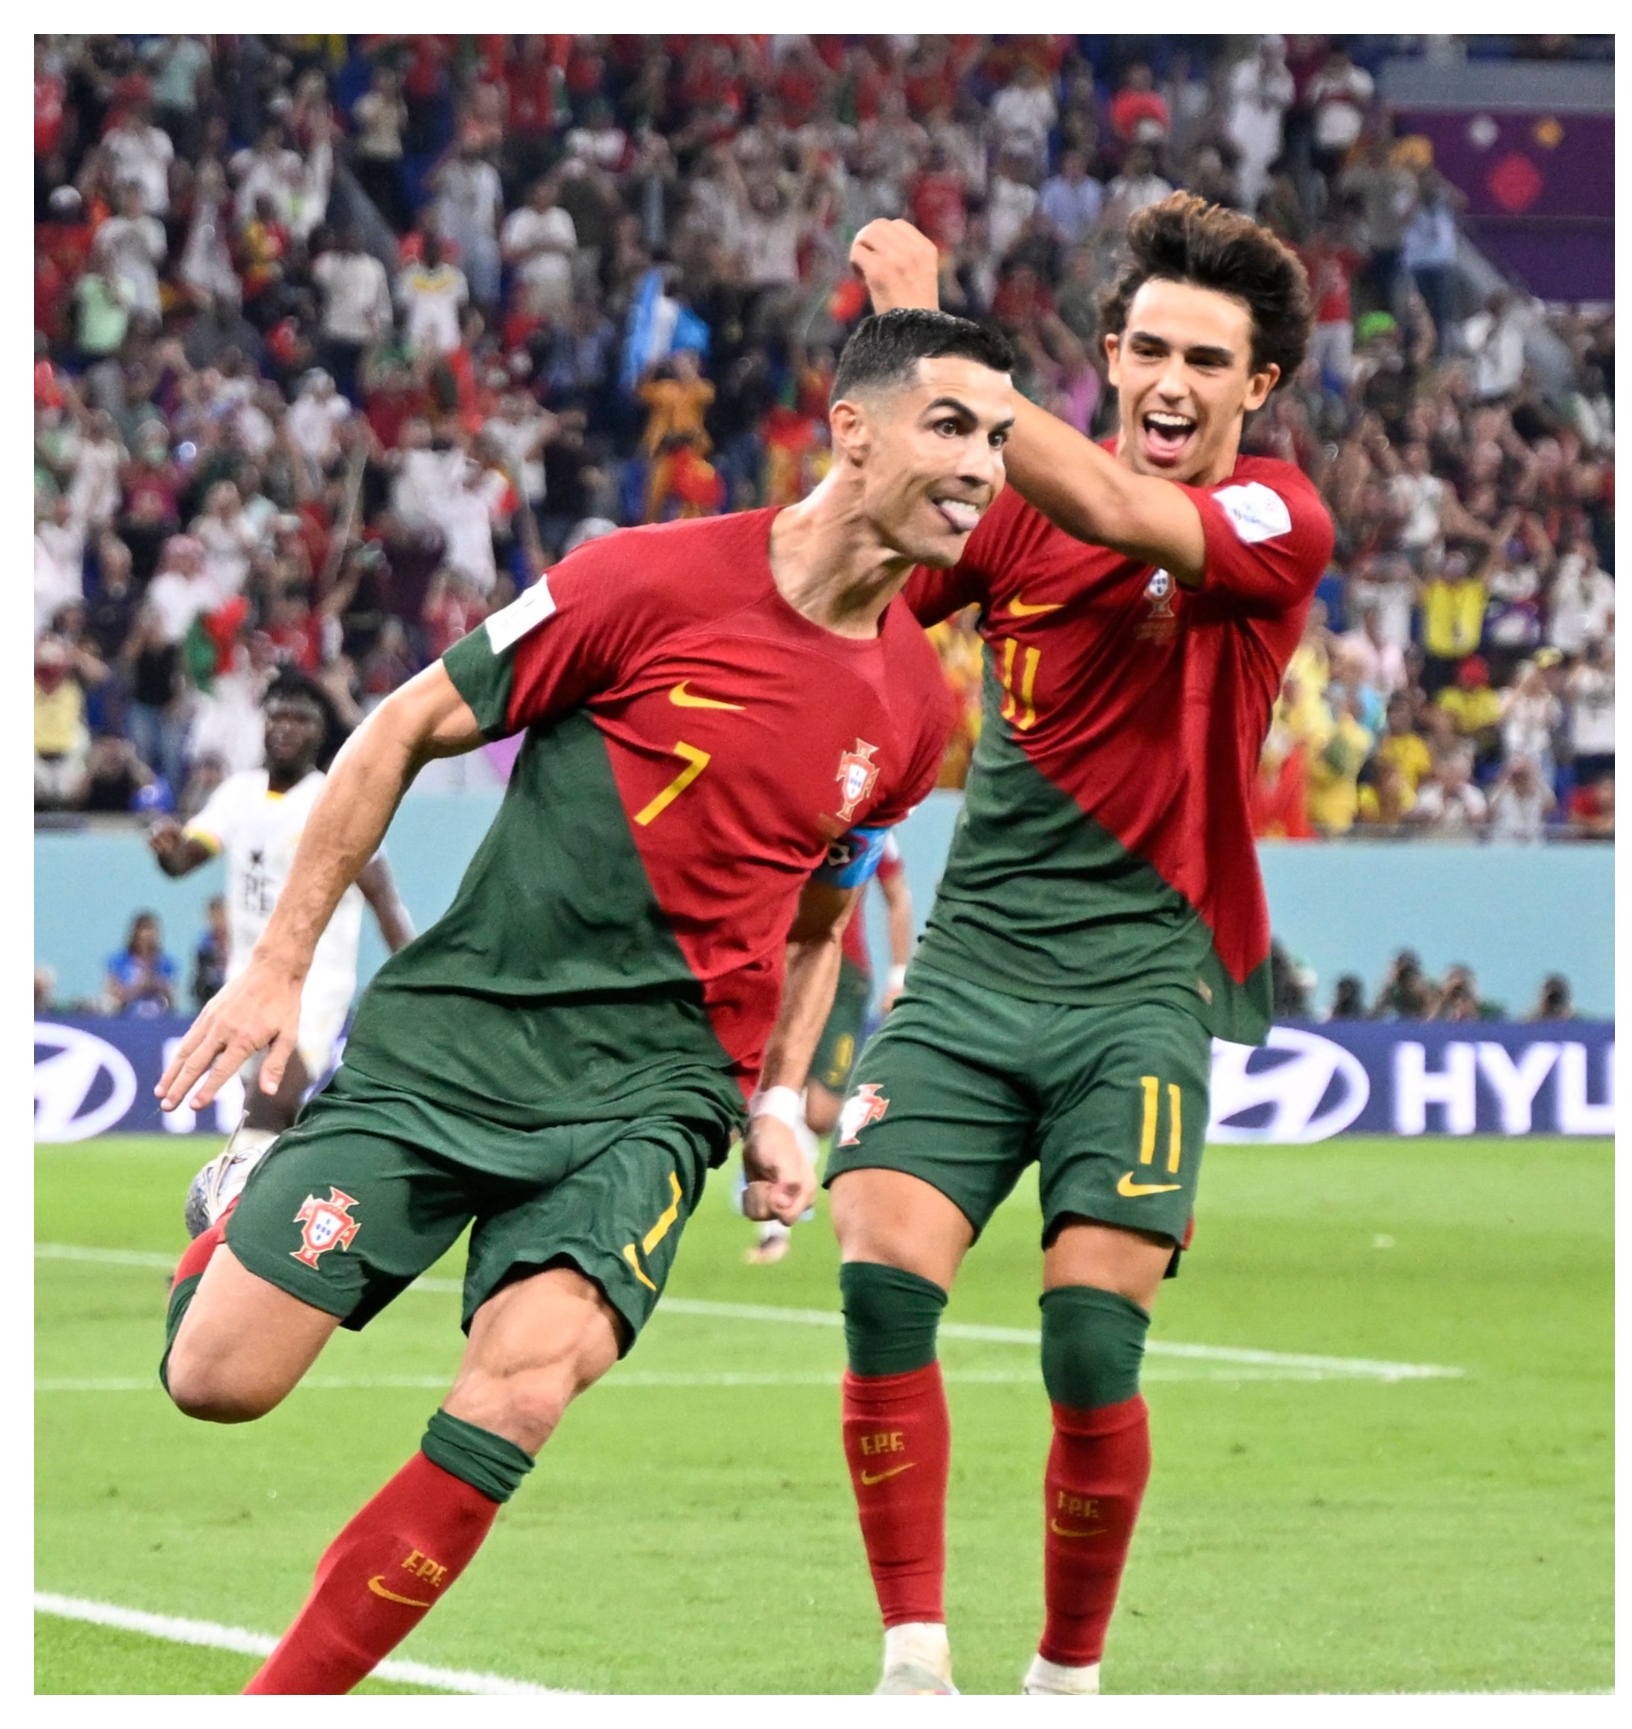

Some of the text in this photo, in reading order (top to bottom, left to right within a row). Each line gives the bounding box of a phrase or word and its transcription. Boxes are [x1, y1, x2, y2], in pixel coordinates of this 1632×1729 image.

[1002, 637, 1042, 731] 11
[633, 740, 712, 827] 7
[1140, 1075, 1182, 1174] 11
